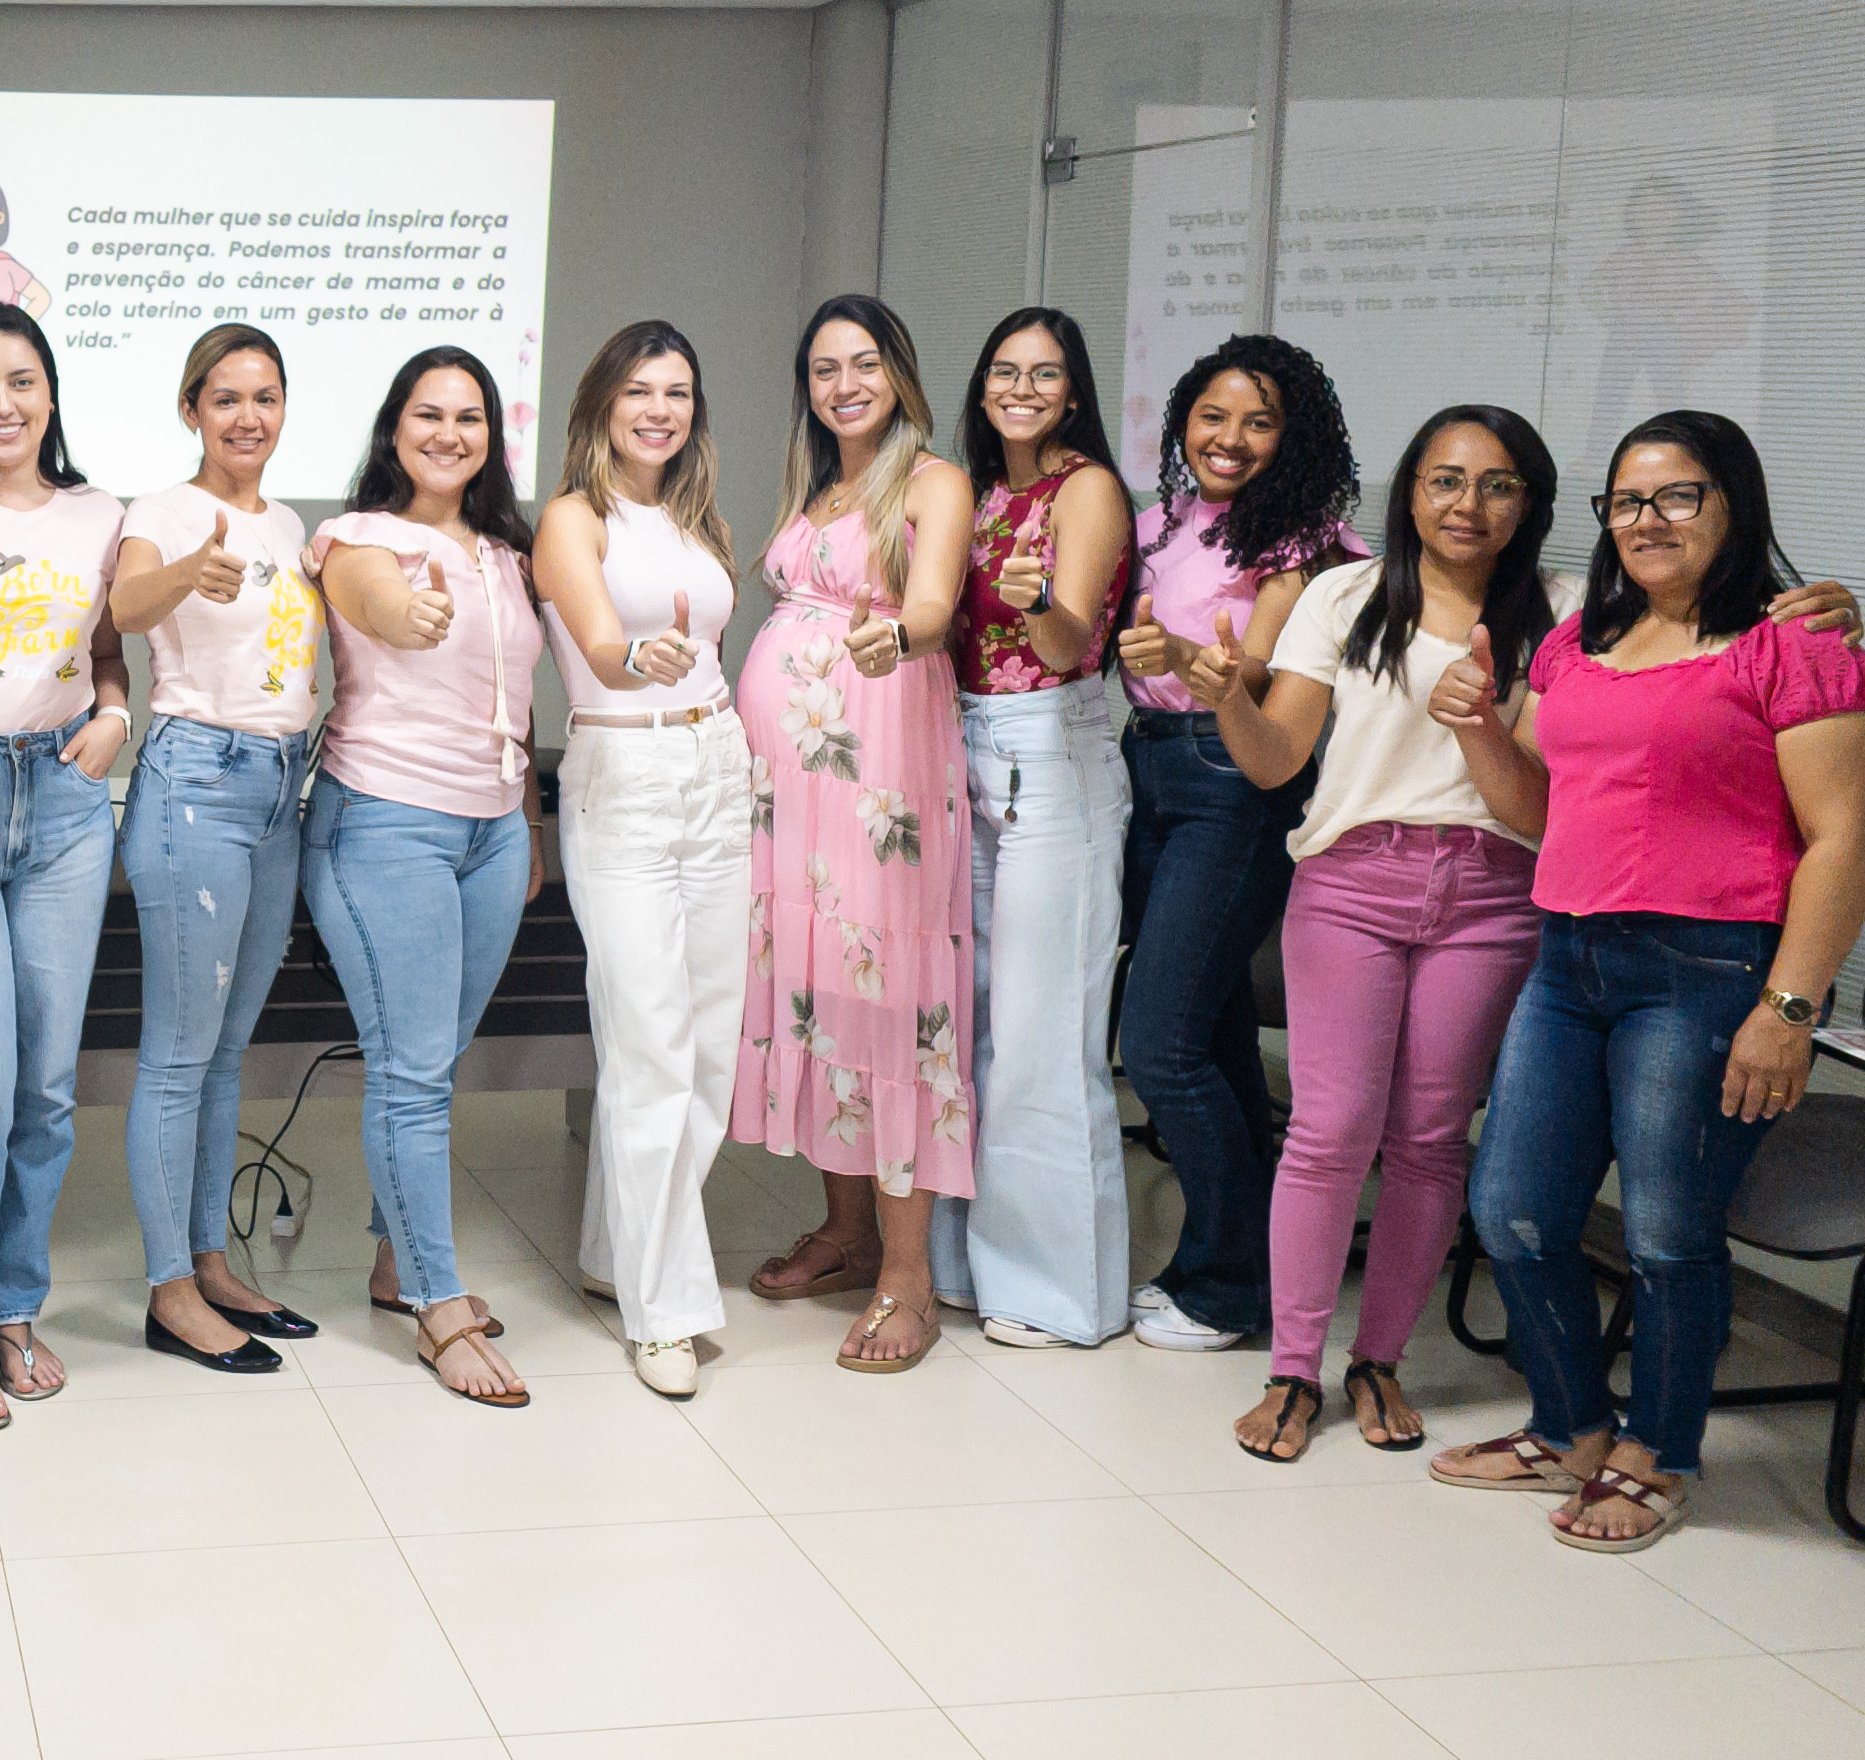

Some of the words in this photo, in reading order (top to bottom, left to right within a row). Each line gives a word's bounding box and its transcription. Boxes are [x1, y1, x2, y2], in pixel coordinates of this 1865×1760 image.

[67, 206, 127, 224] Cada
[133, 207, 215, 226] mulher
[219, 212, 262, 232] que
[267, 212, 292, 227] se
[297, 208, 361, 228] cuida
[366, 208, 445, 234] inspira
[449, 209, 509, 234] força
[66, 241, 80, 255] e
[91, 242, 215, 263] esperança.
[228, 240, 331, 259] Podemos
[344, 240, 482, 260] transformar
[492, 245, 507, 260] a
[65, 270, 185, 293] prevenção
[197, 271, 225, 289] do
[237, 271, 315, 290] câncer
[326, 272, 354, 290] de
[365, 276, 441, 291] mama
[452, 277, 465, 291] e
[477, 273, 506, 291] do
[65, 300, 111, 318] colo
[123, 300, 202, 319] uterino
[213, 306, 248, 320] em
[260, 307, 296, 320] um
[306, 304, 369, 326] gesto
[379, 303, 407, 321] de
[418, 307, 480, 321] amor
[489, 302, 504, 321] à
